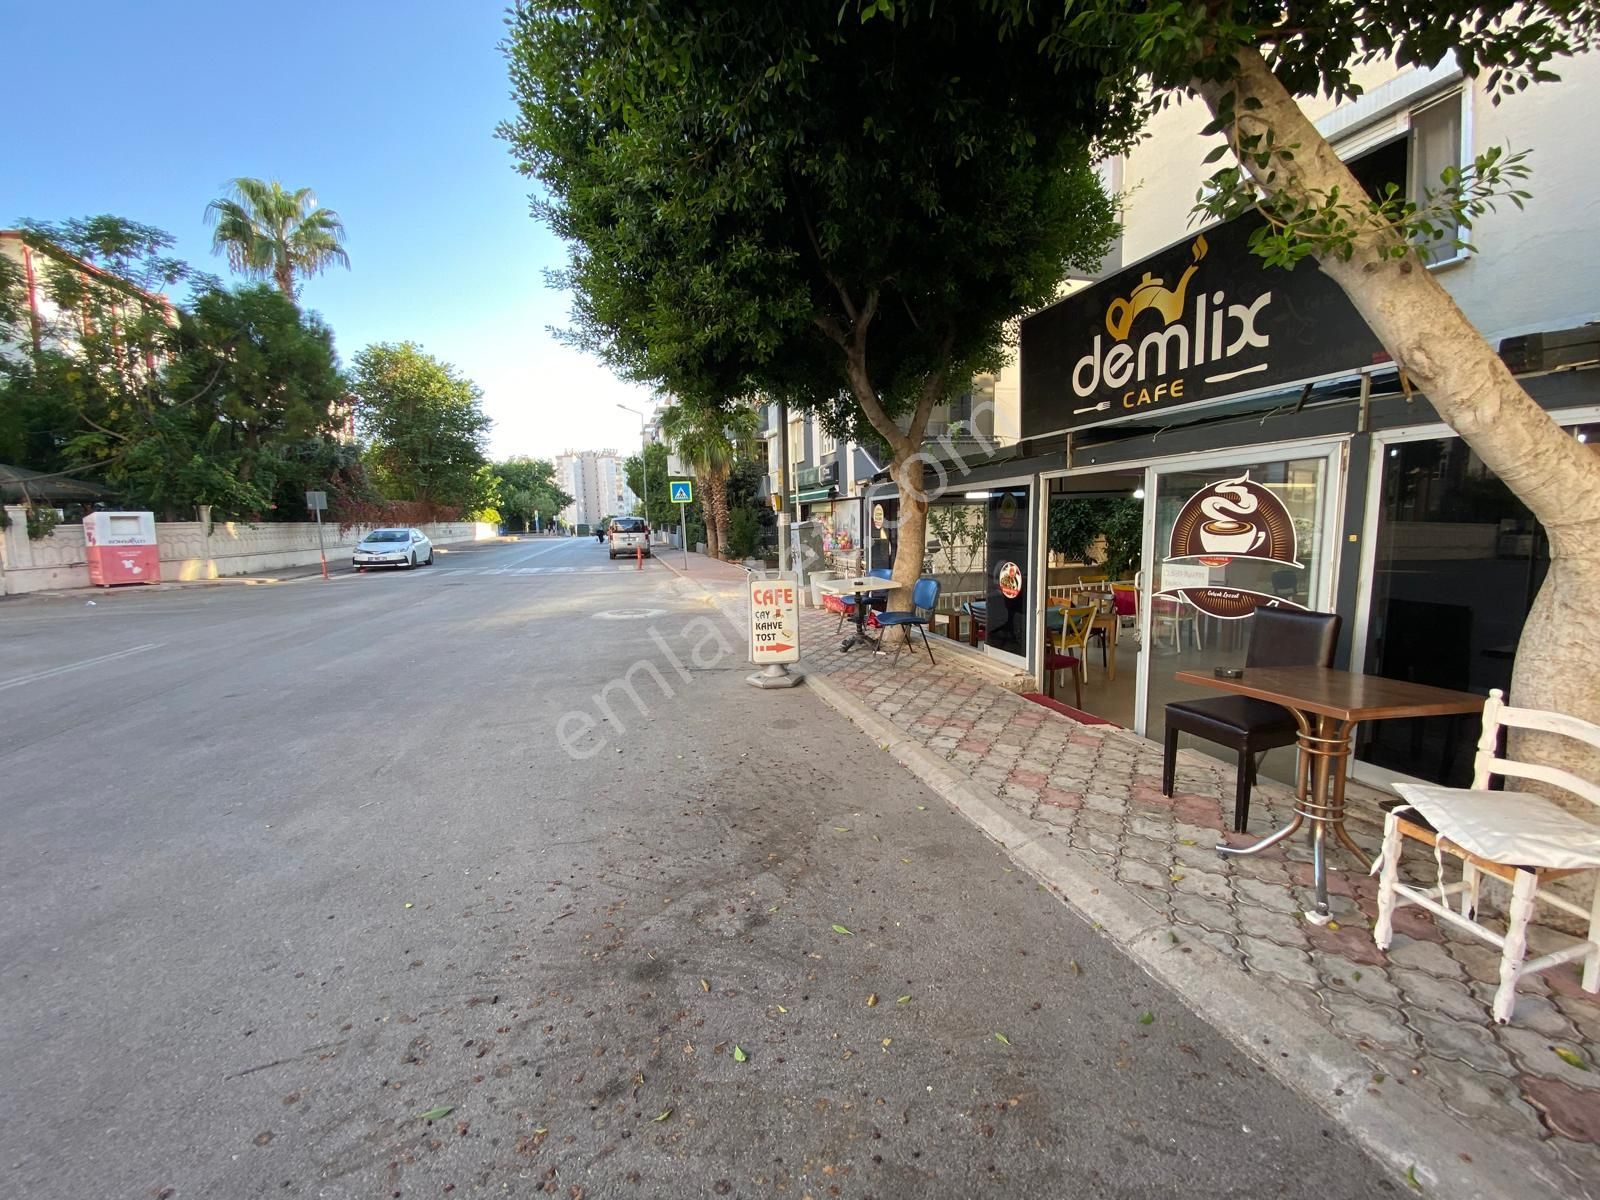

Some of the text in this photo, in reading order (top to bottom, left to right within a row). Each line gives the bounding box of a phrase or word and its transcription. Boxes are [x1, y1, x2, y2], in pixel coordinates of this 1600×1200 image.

[1072, 290, 1272, 397] demlix
[1123, 378, 1185, 409] CAFE
[753, 588, 793, 606] CAFE
[755, 610, 770, 621] ÇAY
[755, 621, 783, 631] KAHVE
[755, 633, 776, 642] TOST
